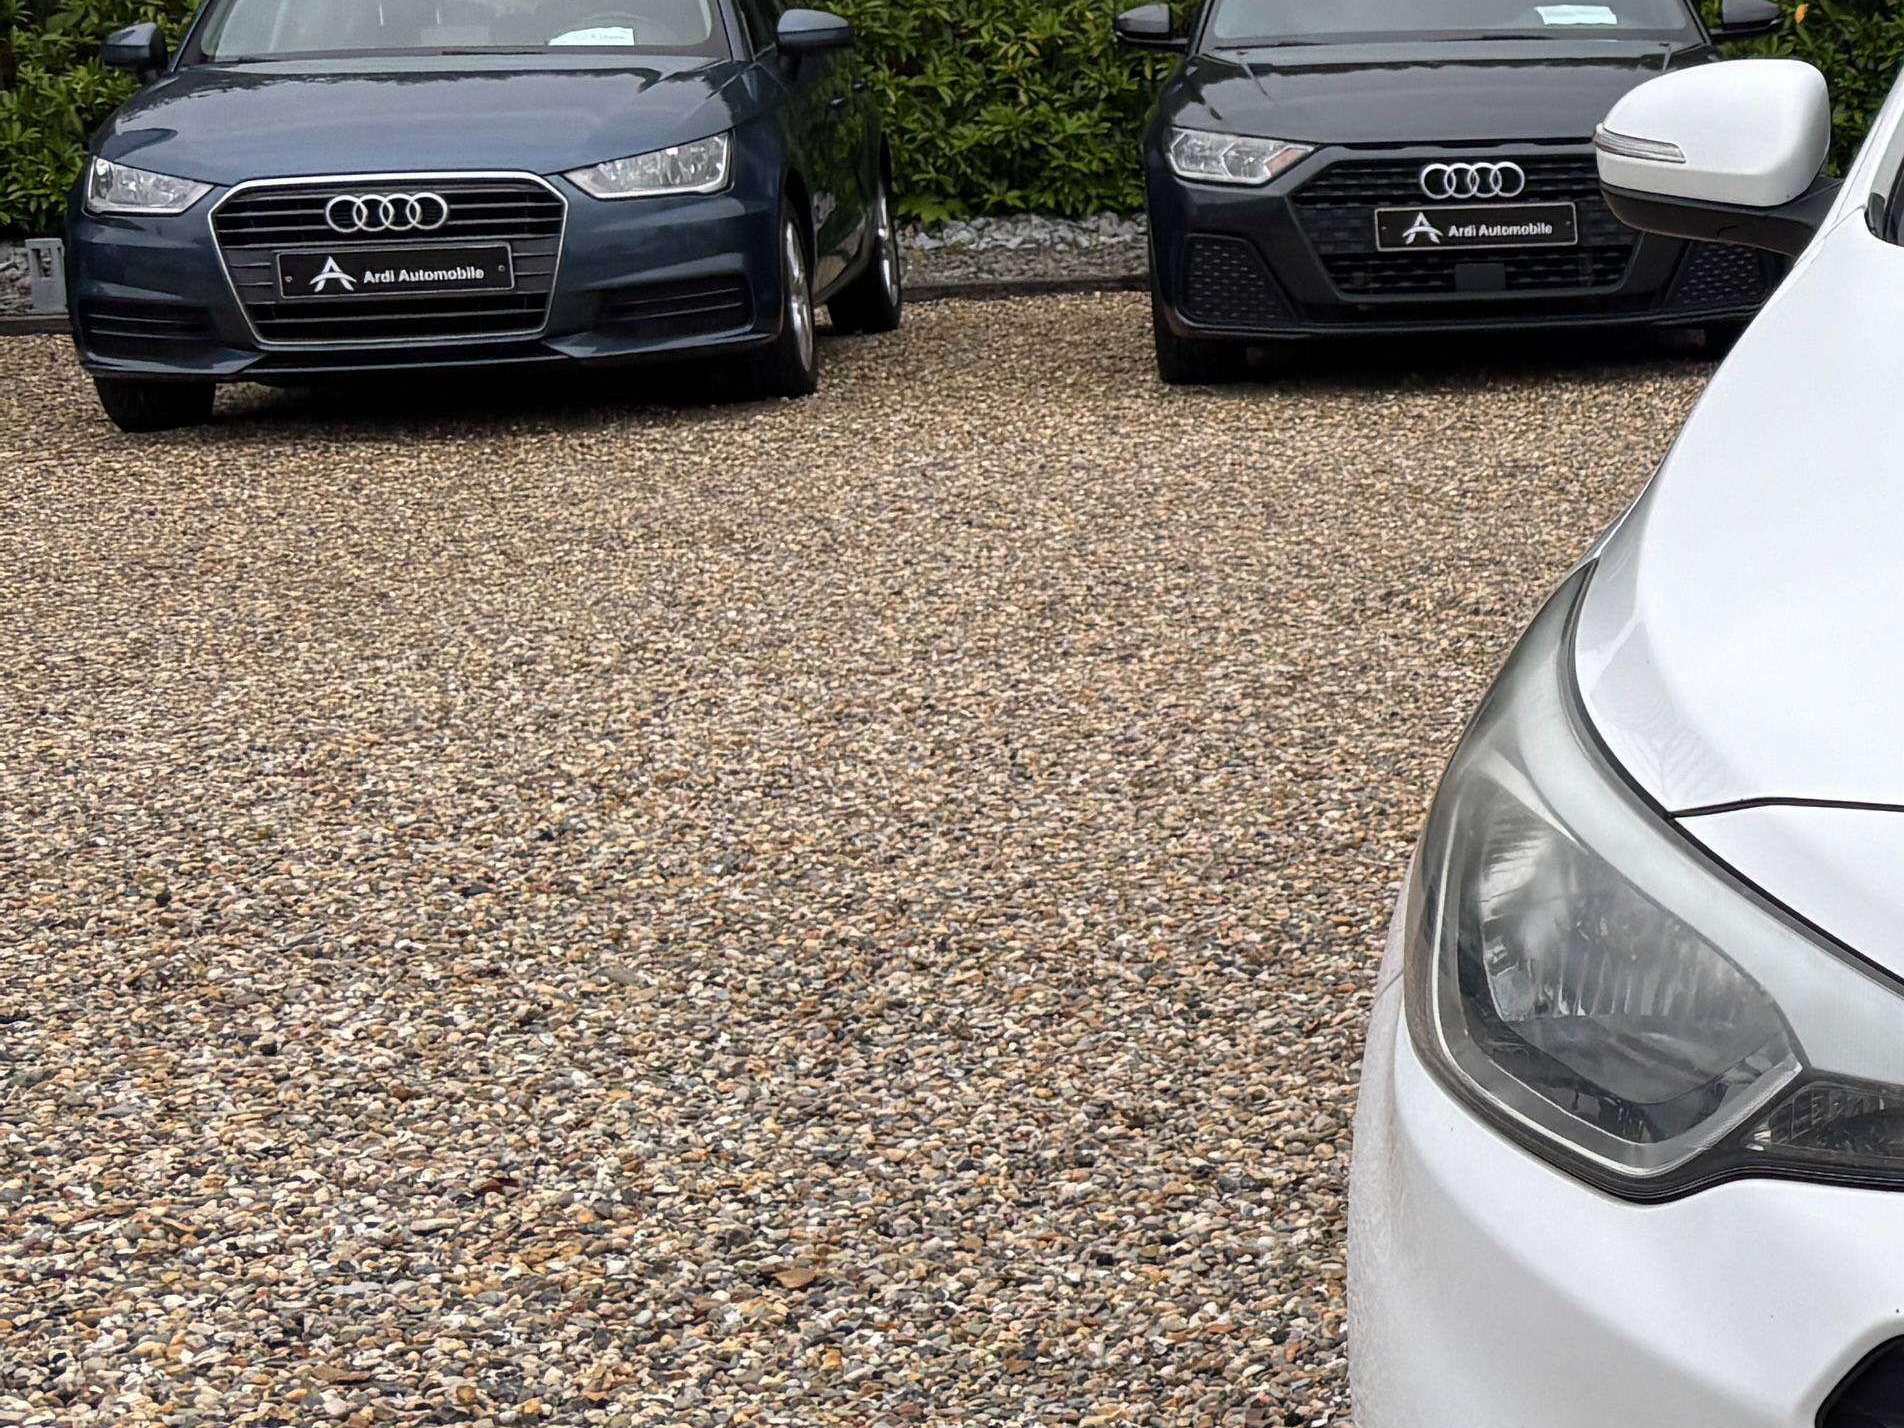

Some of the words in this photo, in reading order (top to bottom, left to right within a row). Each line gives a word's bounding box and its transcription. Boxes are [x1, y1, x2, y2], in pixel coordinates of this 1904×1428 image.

[1448, 224, 1476, 237] Ardi
[1478, 222, 1553, 237] Automobile
[363, 269, 395, 284] Ardi
[398, 266, 485, 282] Automobile
